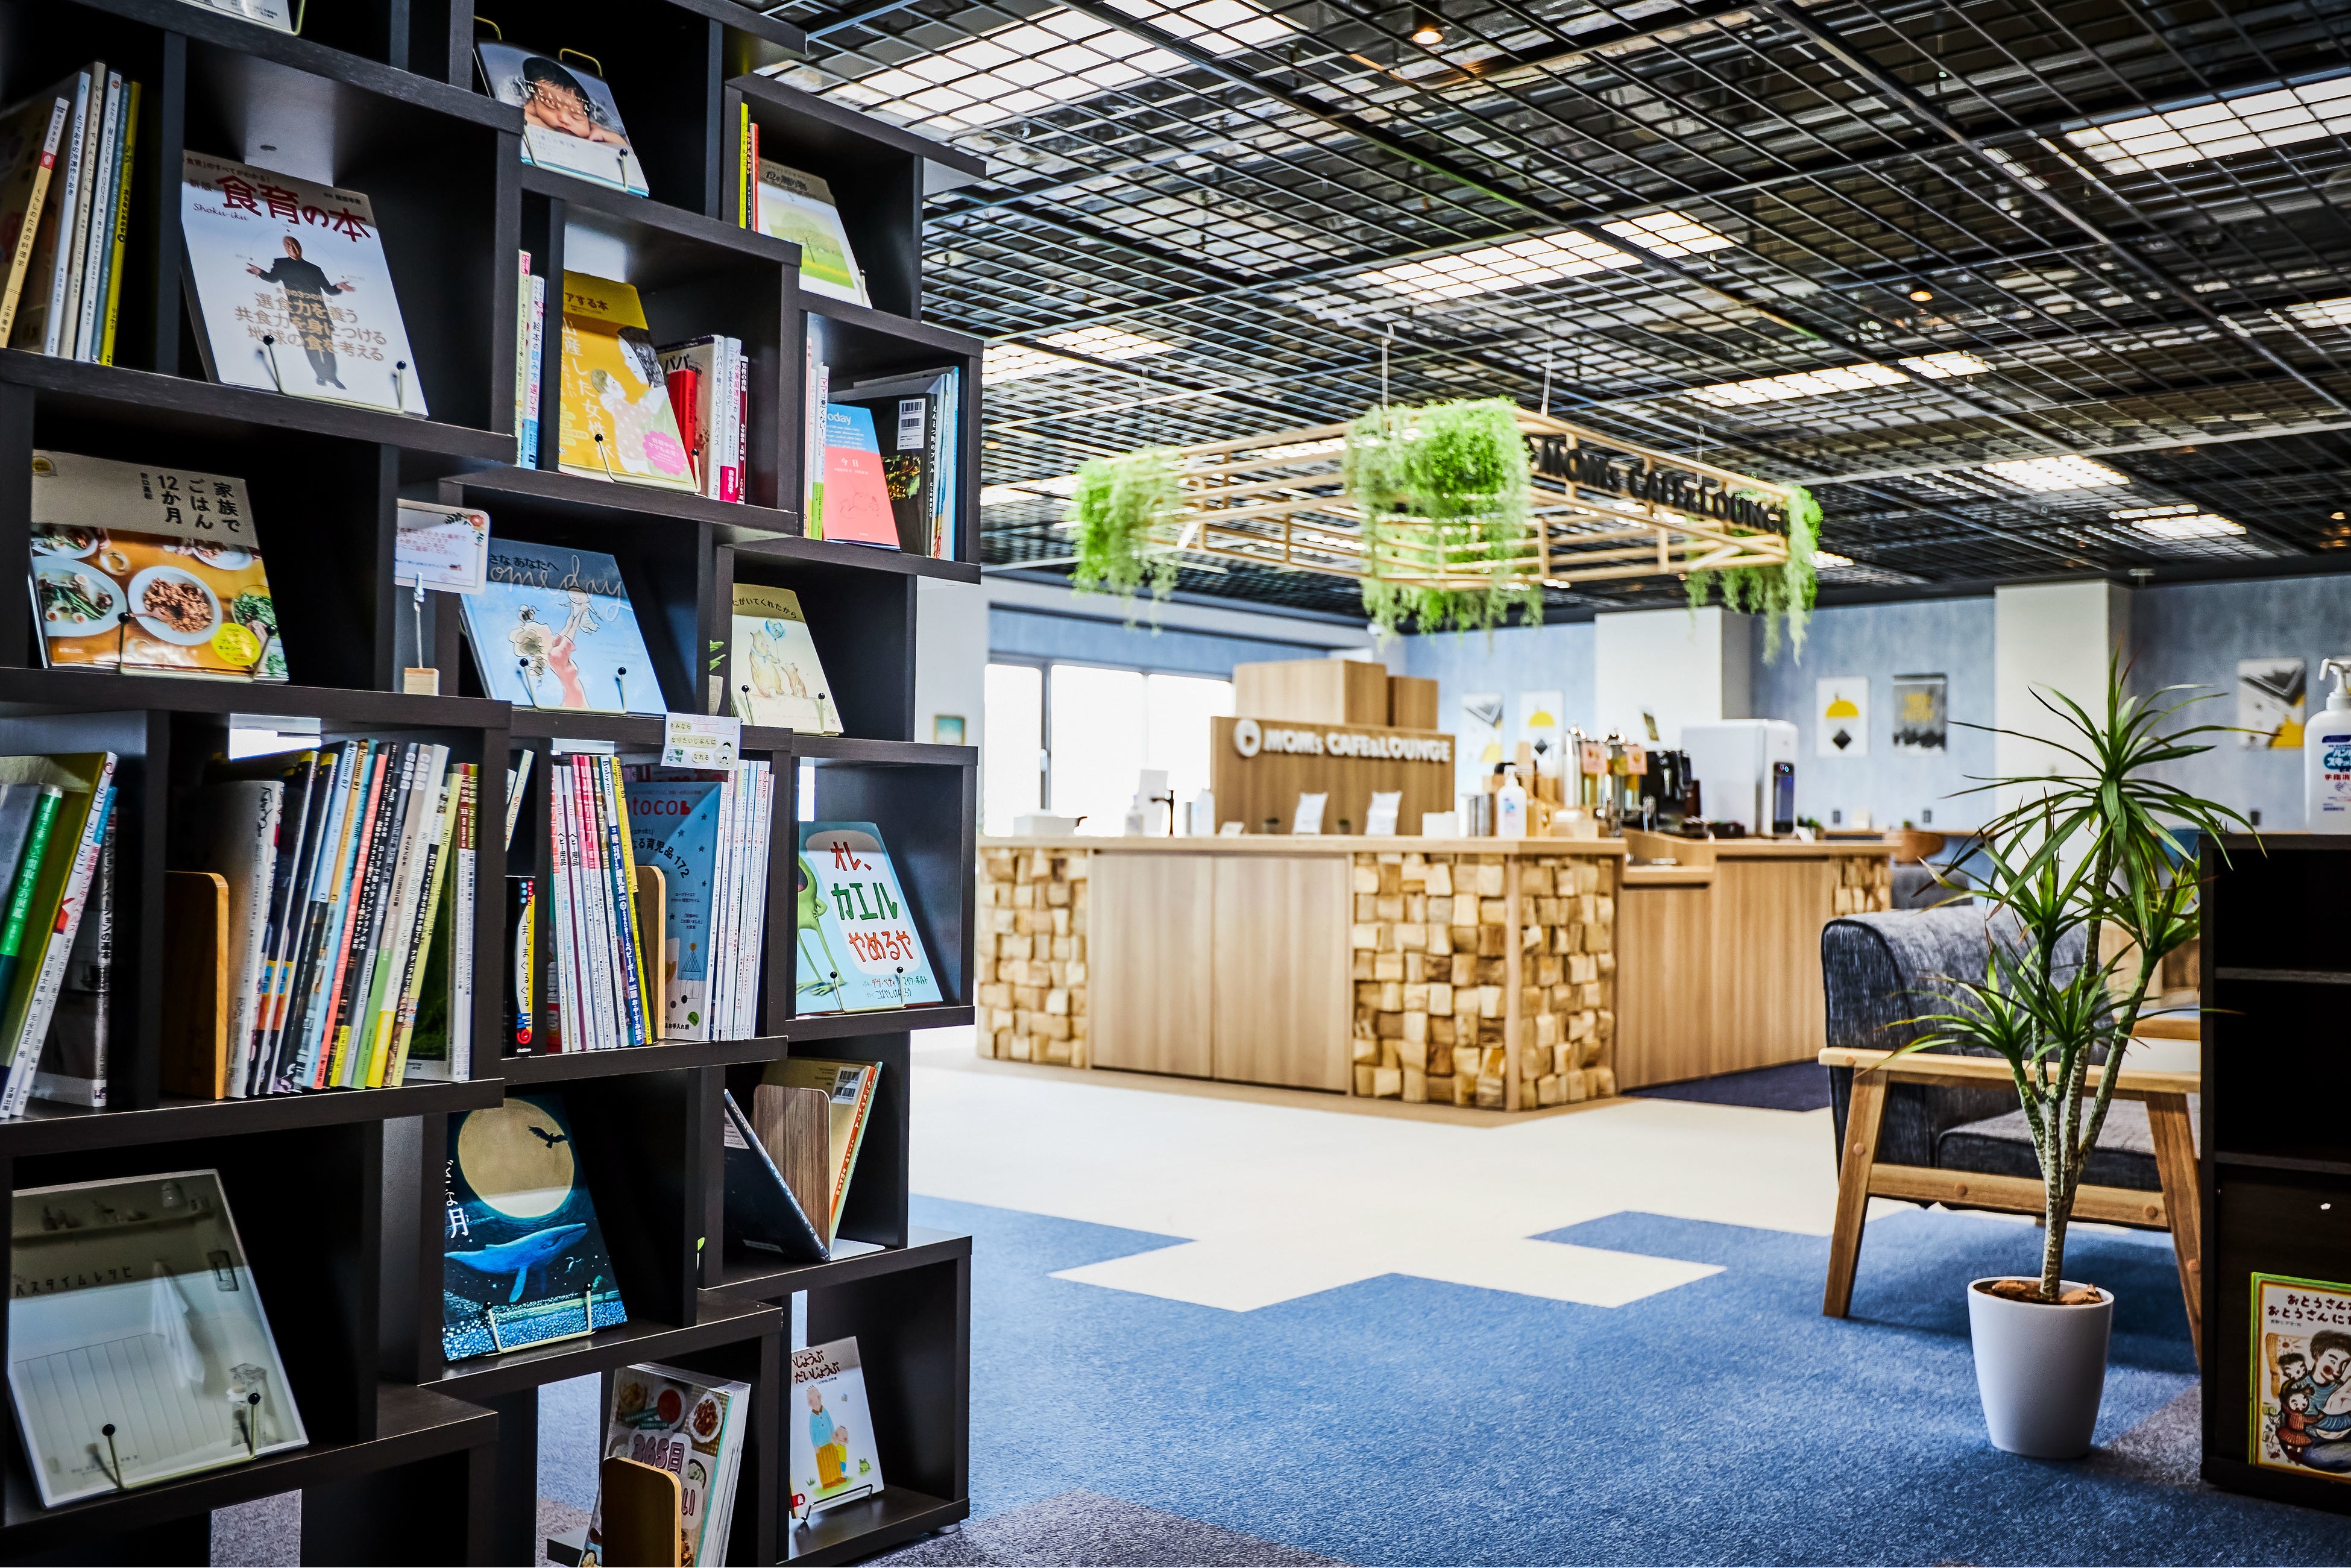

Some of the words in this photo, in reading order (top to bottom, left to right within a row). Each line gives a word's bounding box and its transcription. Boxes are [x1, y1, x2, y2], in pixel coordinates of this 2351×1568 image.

[193, 203, 249, 222] Shoku-iku
[215, 175, 372, 243] 食育の本
[234, 306, 387, 346] 共食力を身につける
[254, 292, 358, 324] 選食力を養う
[247, 325, 384, 362] 地球の食を考える
[157, 474, 183, 524] 12か月
[188, 478, 214, 530] ごはん
[213, 482, 241, 533] 家族で
[674, 855, 691, 879] 172
[829, 841, 872, 872] オレ、
[831, 882, 898, 921] カエル
[521, 913, 532, 1007] しましまぐるぐる
[848, 930, 913, 963] やめるや
[875, 987, 912, 1000] こばやしけんろう
[794, 1361, 841, 1385] だいじょうぶ
[631, 1433, 685, 1475] 365日
